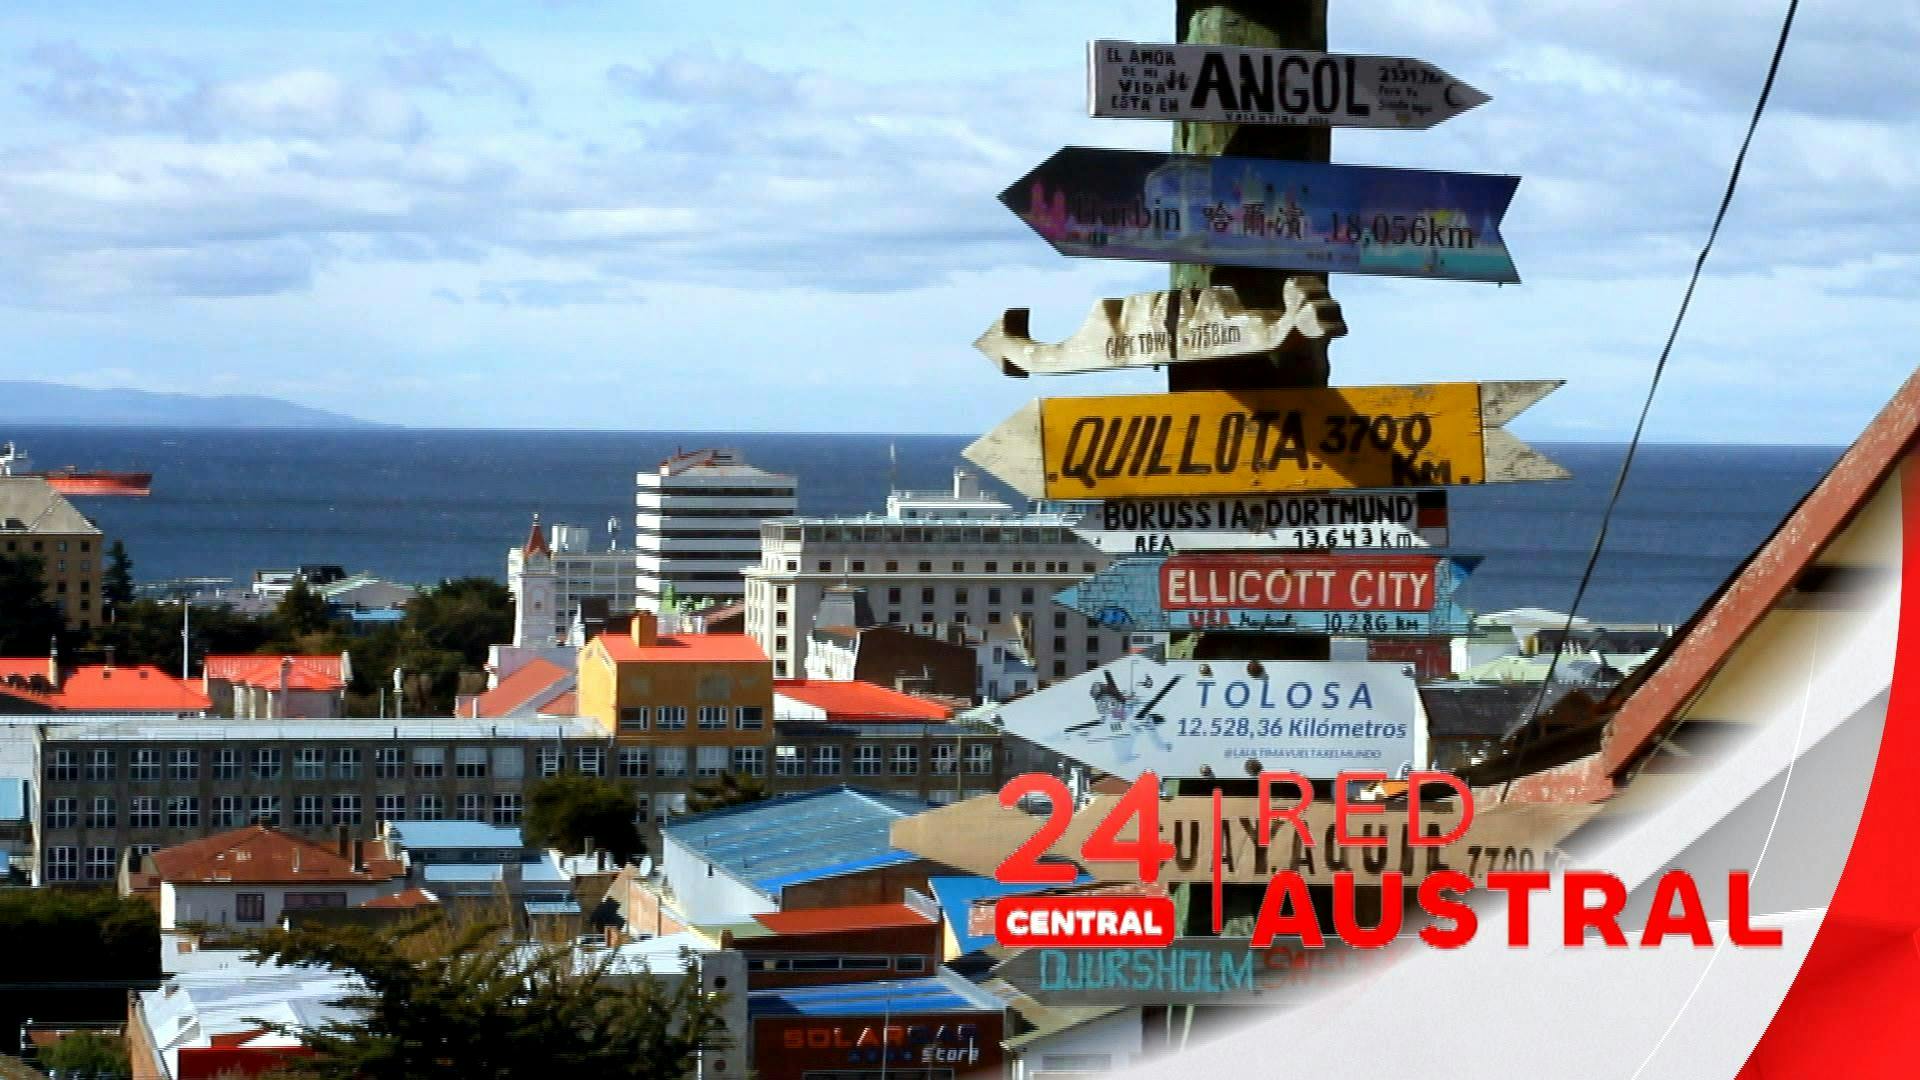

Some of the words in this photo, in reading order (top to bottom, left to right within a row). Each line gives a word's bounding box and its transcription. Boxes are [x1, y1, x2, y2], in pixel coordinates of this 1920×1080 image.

[1106, 47, 1121, 63] EL
[1129, 49, 1175, 66] AMOR
[1119, 80, 1165, 95] VIDA
[1188, 50, 1370, 116] ANGOL
[1329, 211, 1474, 249] 18,056km
[1061, 409, 1308, 482] QUILLOTA
[1319, 412, 1432, 454] 3700
[1104, 499, 1256, 530] BORUSSIA
[1265, 494, 1414, 526] DORTMUND
[1167, 570, 1332, 605] ELLICOTT
[1350, 569, 1429, 607] CITY
[1197, 681, 1374, 710] TOLOSA
[1177, 718, 1283, 740] 12.528,36
[1289, 717, 1407, 739] Kilómetros
[1039, 949, 1254, 993] DJURSHOLM
